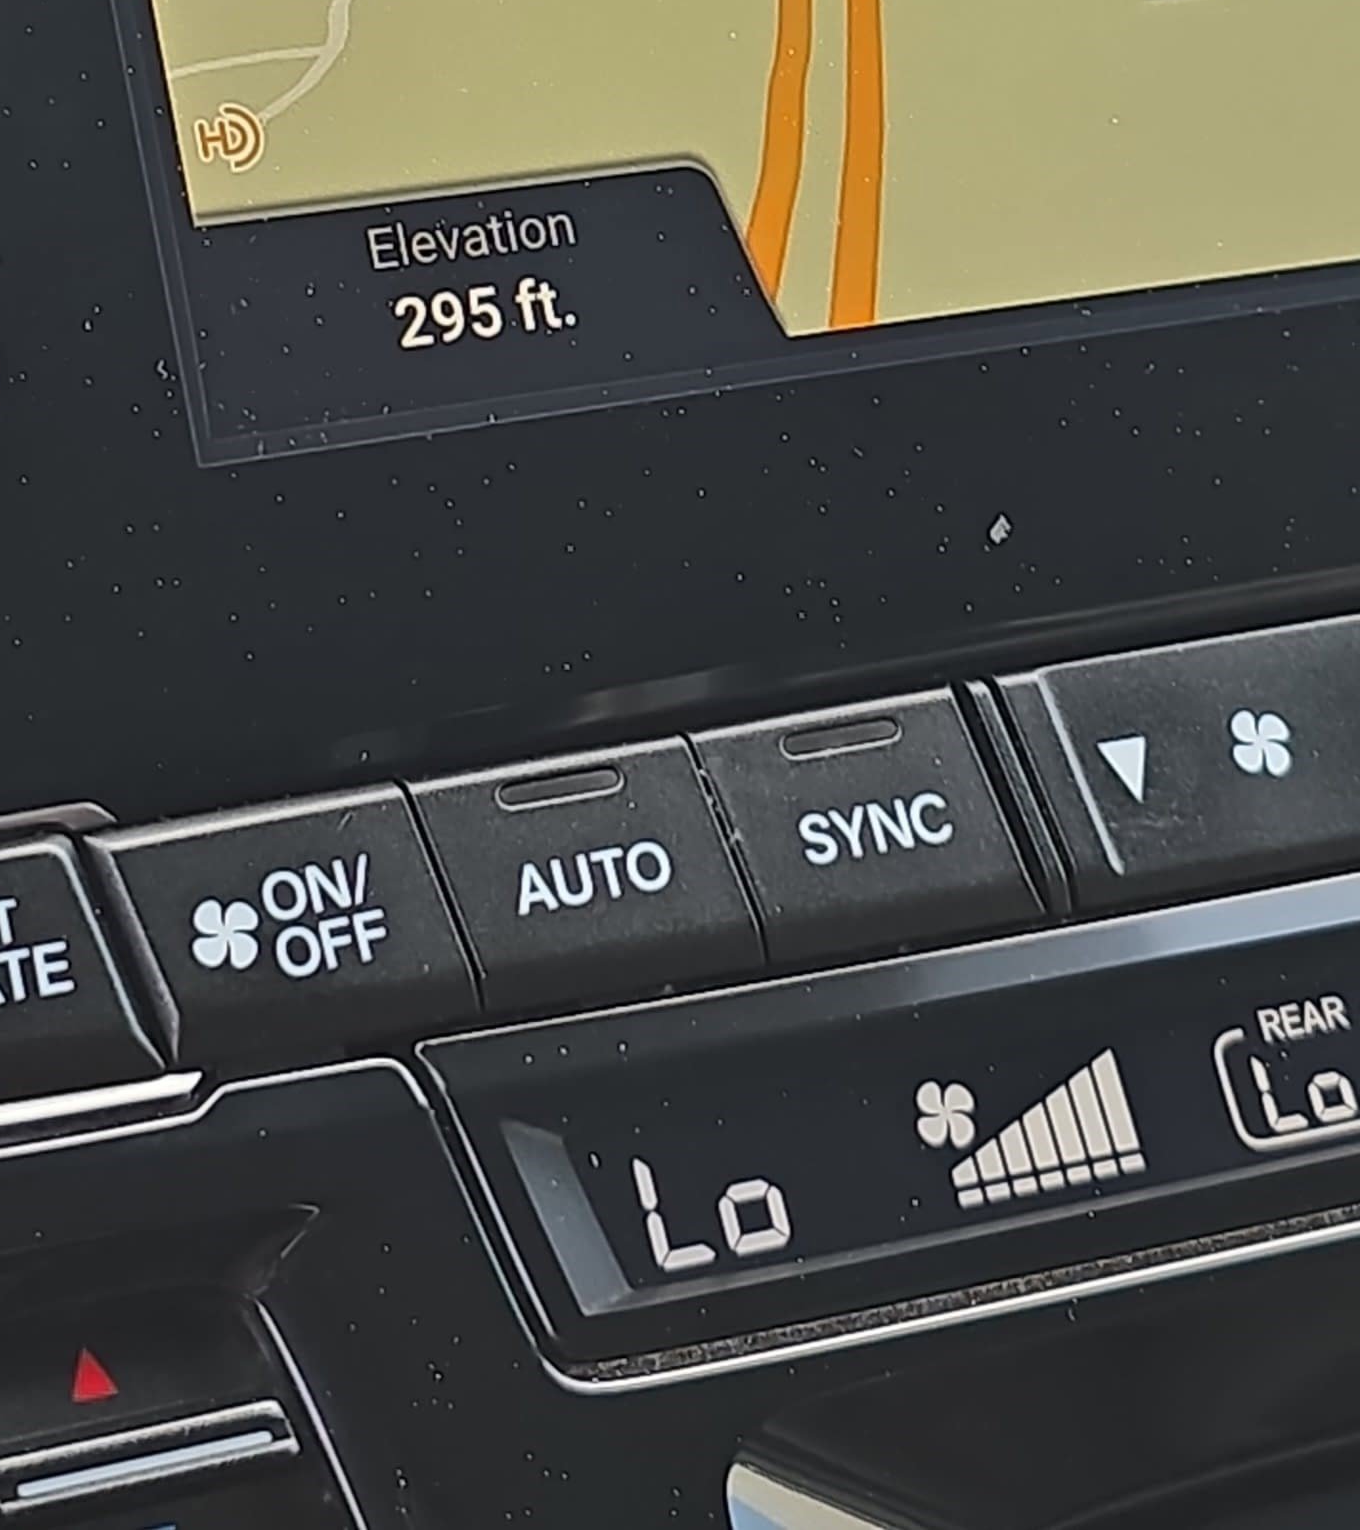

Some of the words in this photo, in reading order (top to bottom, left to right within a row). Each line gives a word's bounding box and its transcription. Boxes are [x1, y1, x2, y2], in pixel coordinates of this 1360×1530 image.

[367, 208, 577, 271] Elevation
[392, 285, 506, 349] 295
[514, 277, 578, 332] ft.
[796, 792, 956, 866] SYNC
[261, 853, 371, 923] ON/
[516, 841, 674, 916] AUTO
[274, 908, 389, 979] OFF
[1256, 996, 1349, 1046] REAR
[1249, 1055, 1359, 1134] Lo
[632, 1157, 792, 1272] Lo
